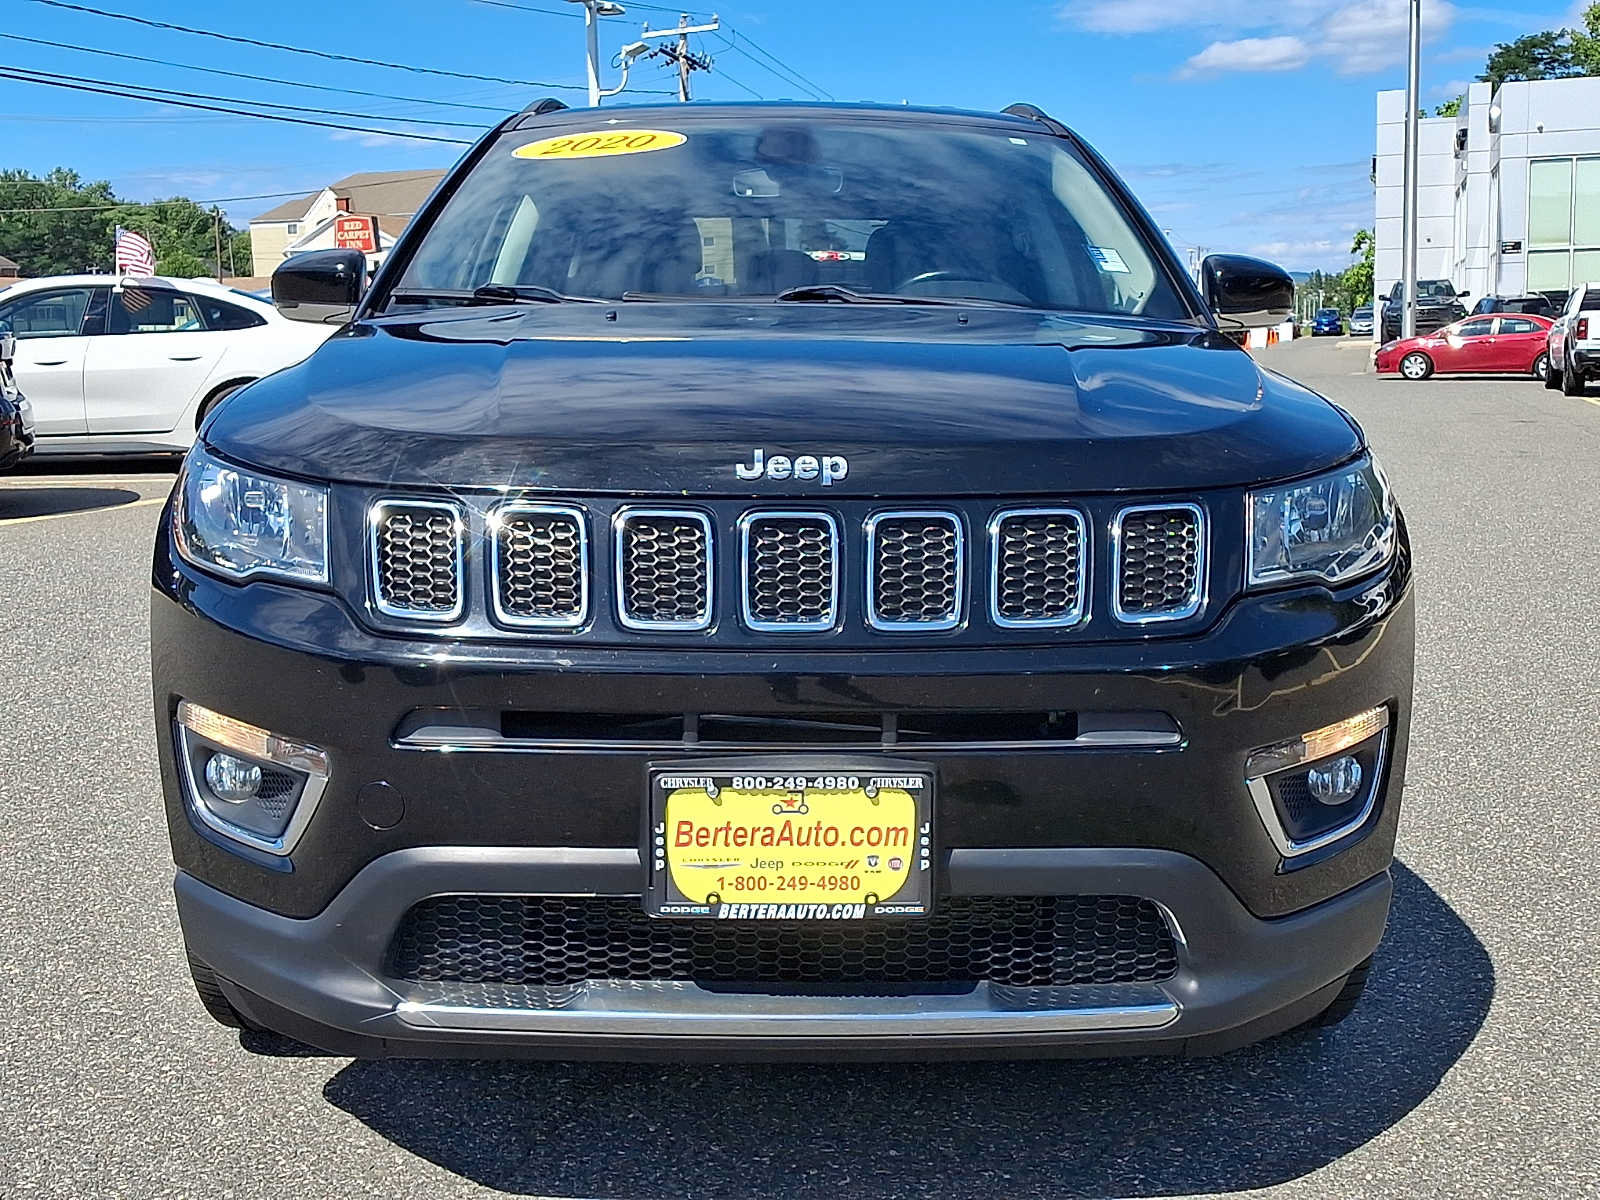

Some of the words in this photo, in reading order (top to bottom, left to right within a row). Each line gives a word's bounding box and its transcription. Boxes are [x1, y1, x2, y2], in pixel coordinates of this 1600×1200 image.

[540, 134, 657, 155] 2020
[344, 221, 362, 230] RED
[338, 230, 370, 240] CARPET
[346, 240, 363, 248] INN
[735, 448, 849, 486] Jeep
[660, 777, 714, 789] CHRYSLER
[732, 777, 860, 790] 800-249-4980
[869, 777, 924, 789] CHRYSLER
[675, 820, 909, 848] BerteraAuto.com
[750, 857, 784, 871] Jeep
[716, 876, 860, 891] 1-800-249-4980
[660, 906, 710, 914] DODGE
[718, 904, 866, 920] BERTERAAUTO.COM
[874, 906, 926, 914] DODGE
